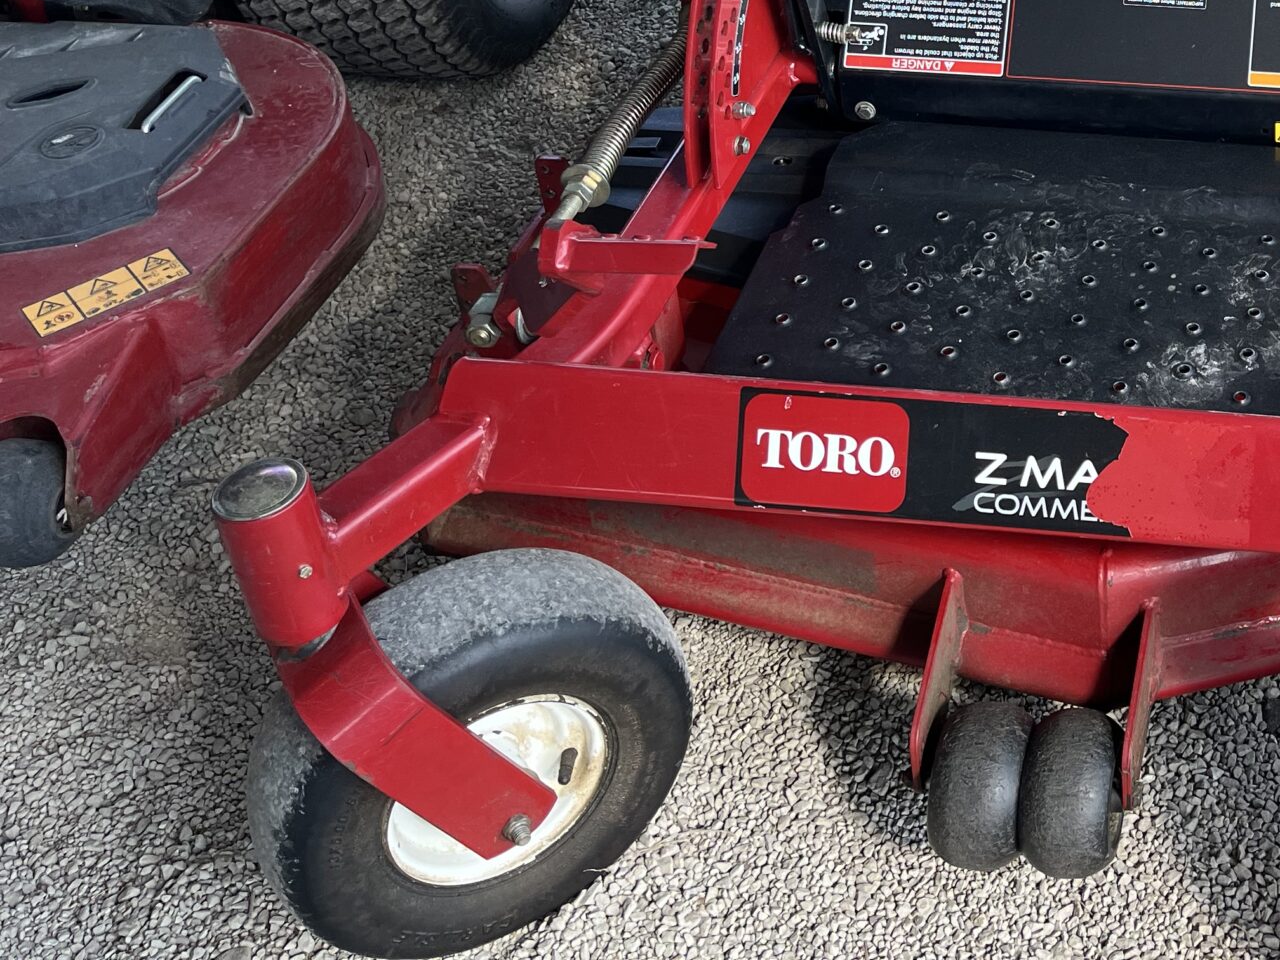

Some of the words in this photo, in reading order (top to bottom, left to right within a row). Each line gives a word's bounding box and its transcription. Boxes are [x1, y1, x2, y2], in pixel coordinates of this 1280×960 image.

[882, 10, 907, 18] changing
[917, 34, 949, 42] bystanders
[953, 50, 974, 58] objects
[891, 58, 941, 69] DANGER
[757, 428, 896, 477] TORO
[974, 451, 1008, 486] Z
